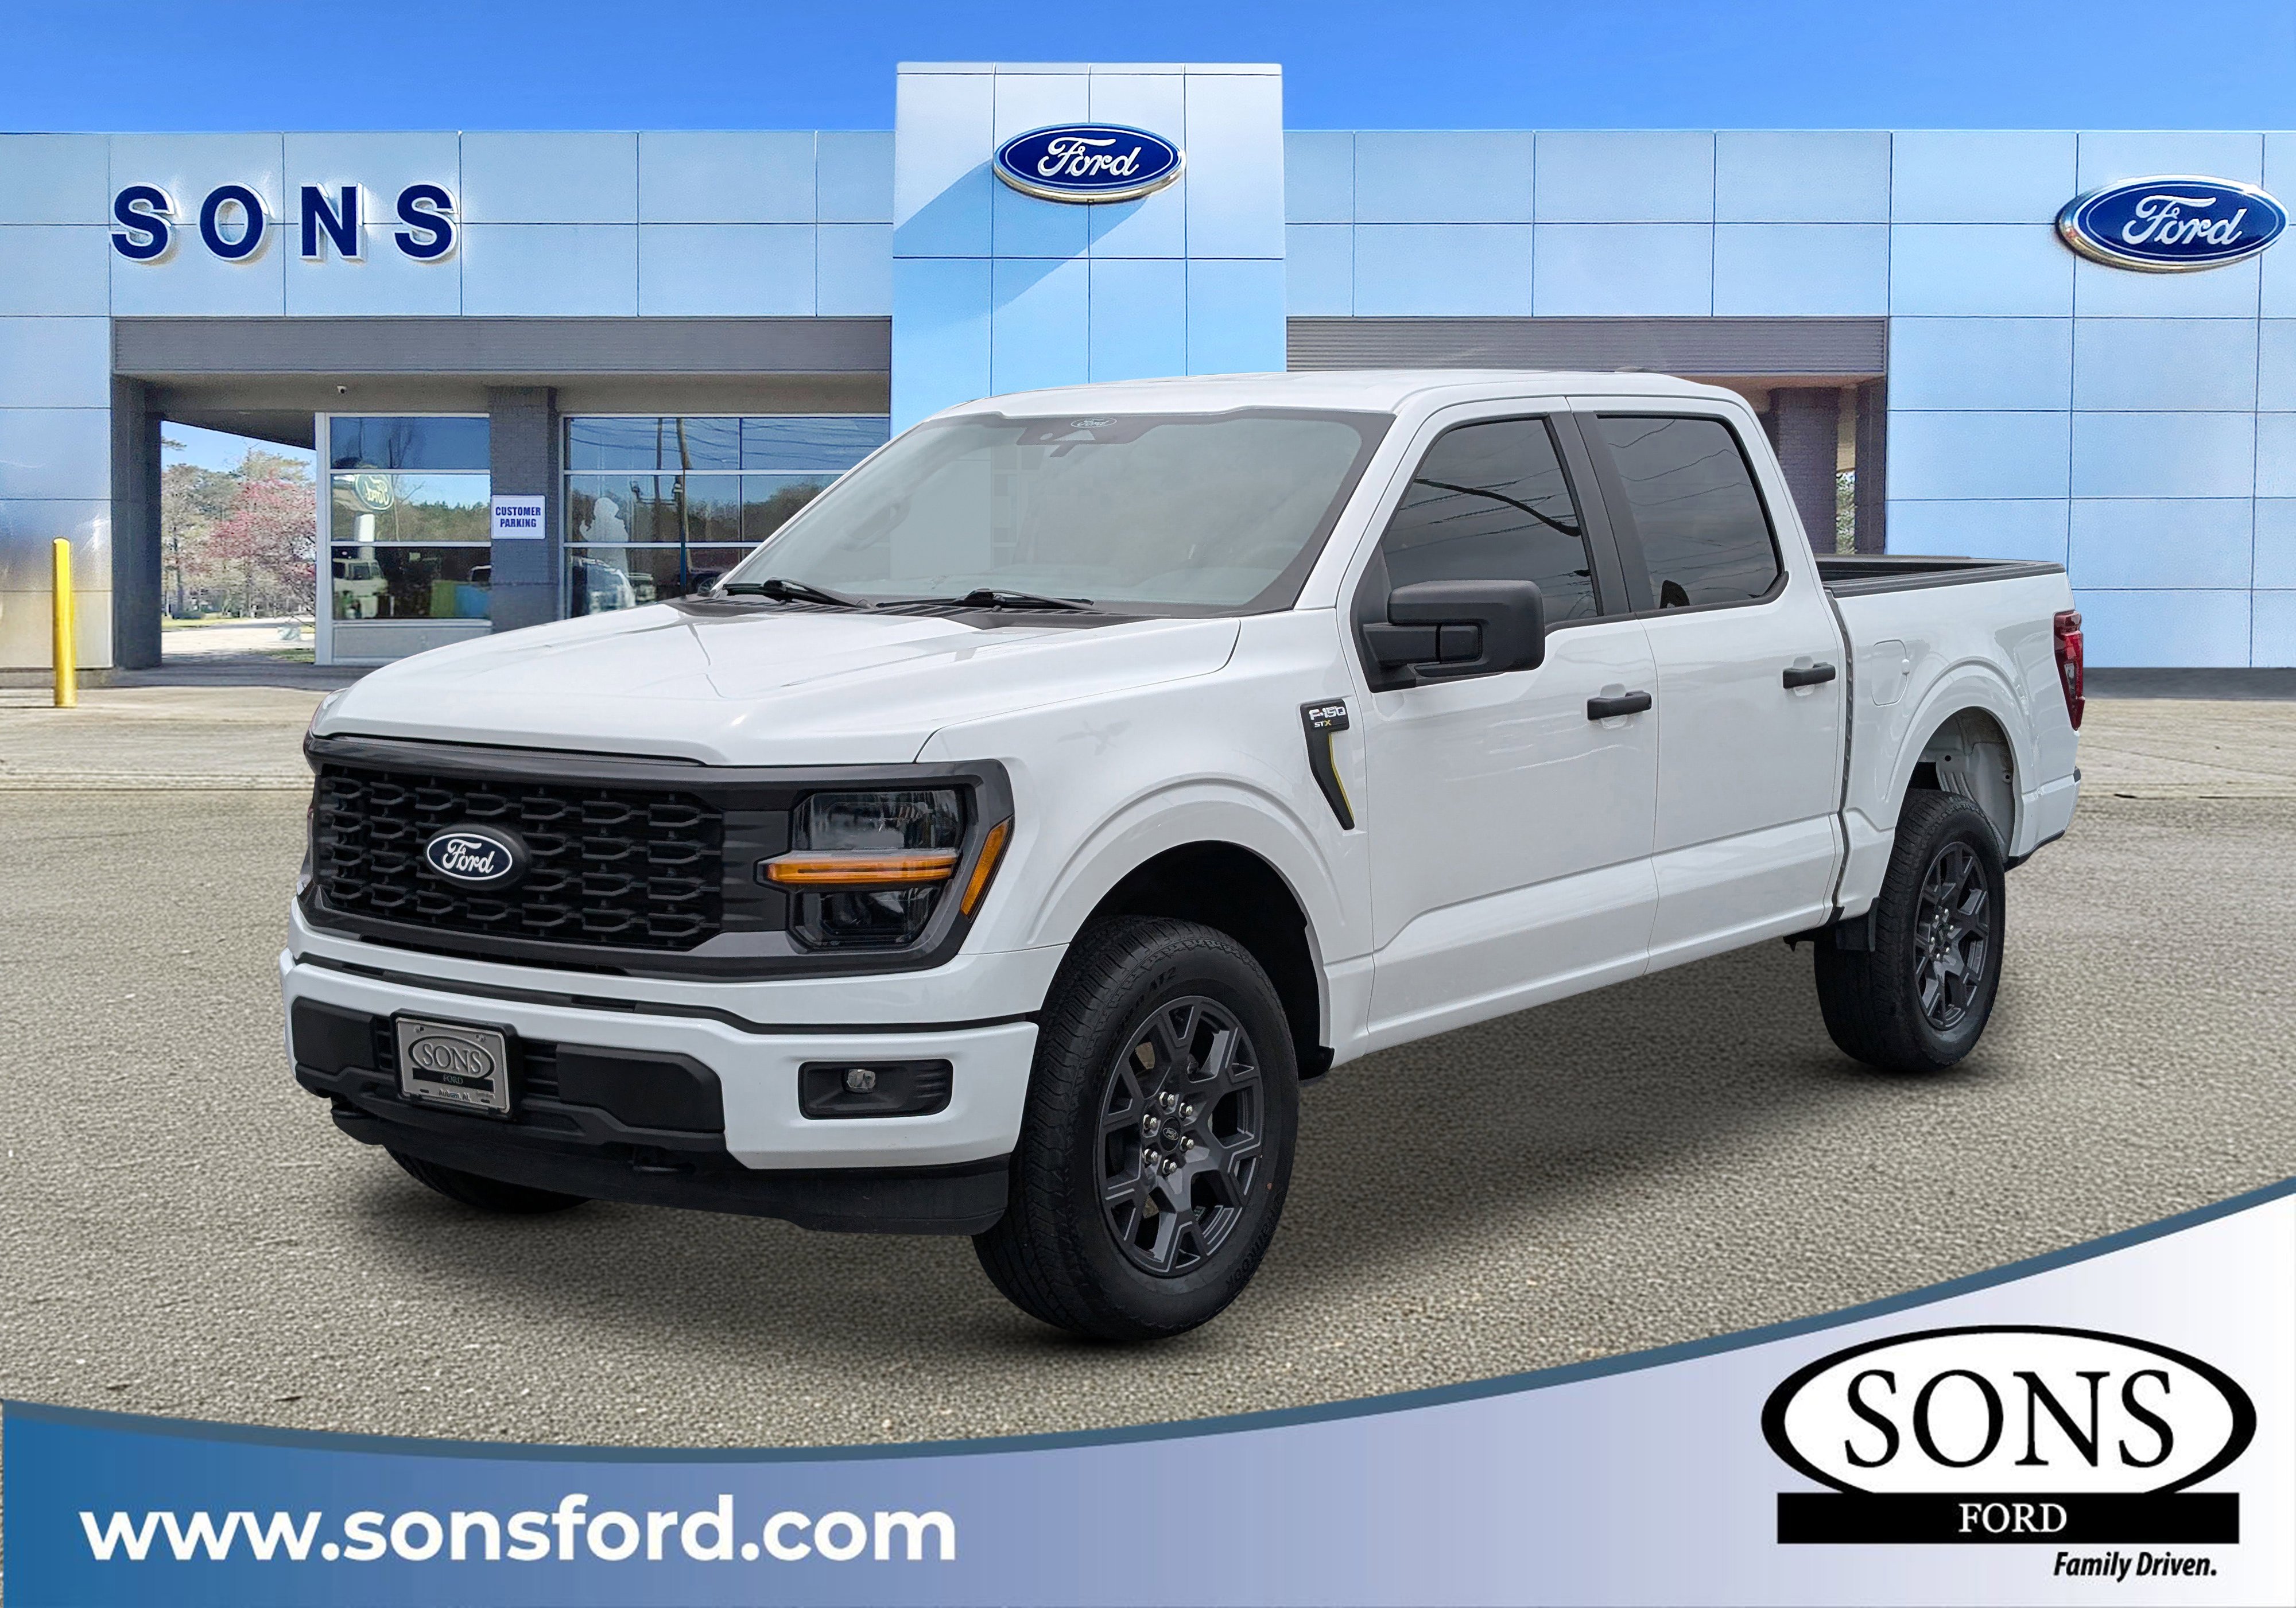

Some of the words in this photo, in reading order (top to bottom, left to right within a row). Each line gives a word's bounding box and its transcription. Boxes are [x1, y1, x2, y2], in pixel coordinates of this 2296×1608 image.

[1037, 137, 1142, 177] Ford
[111, 184, 456, 260] SONS
[2122, 195, 2248, 245] Ford
[495, 506, 541, 516] CUSTOMER
[500, 518, 537, 528] PARKING
[1309, 706, 1346, 720] F-150
[1314, 719, 1332, 728] STX
[443, 838, 495, 873] Ford
[422, 1042, 483, 1074] SONS
[443, 1074, 463, 1085] FORD
